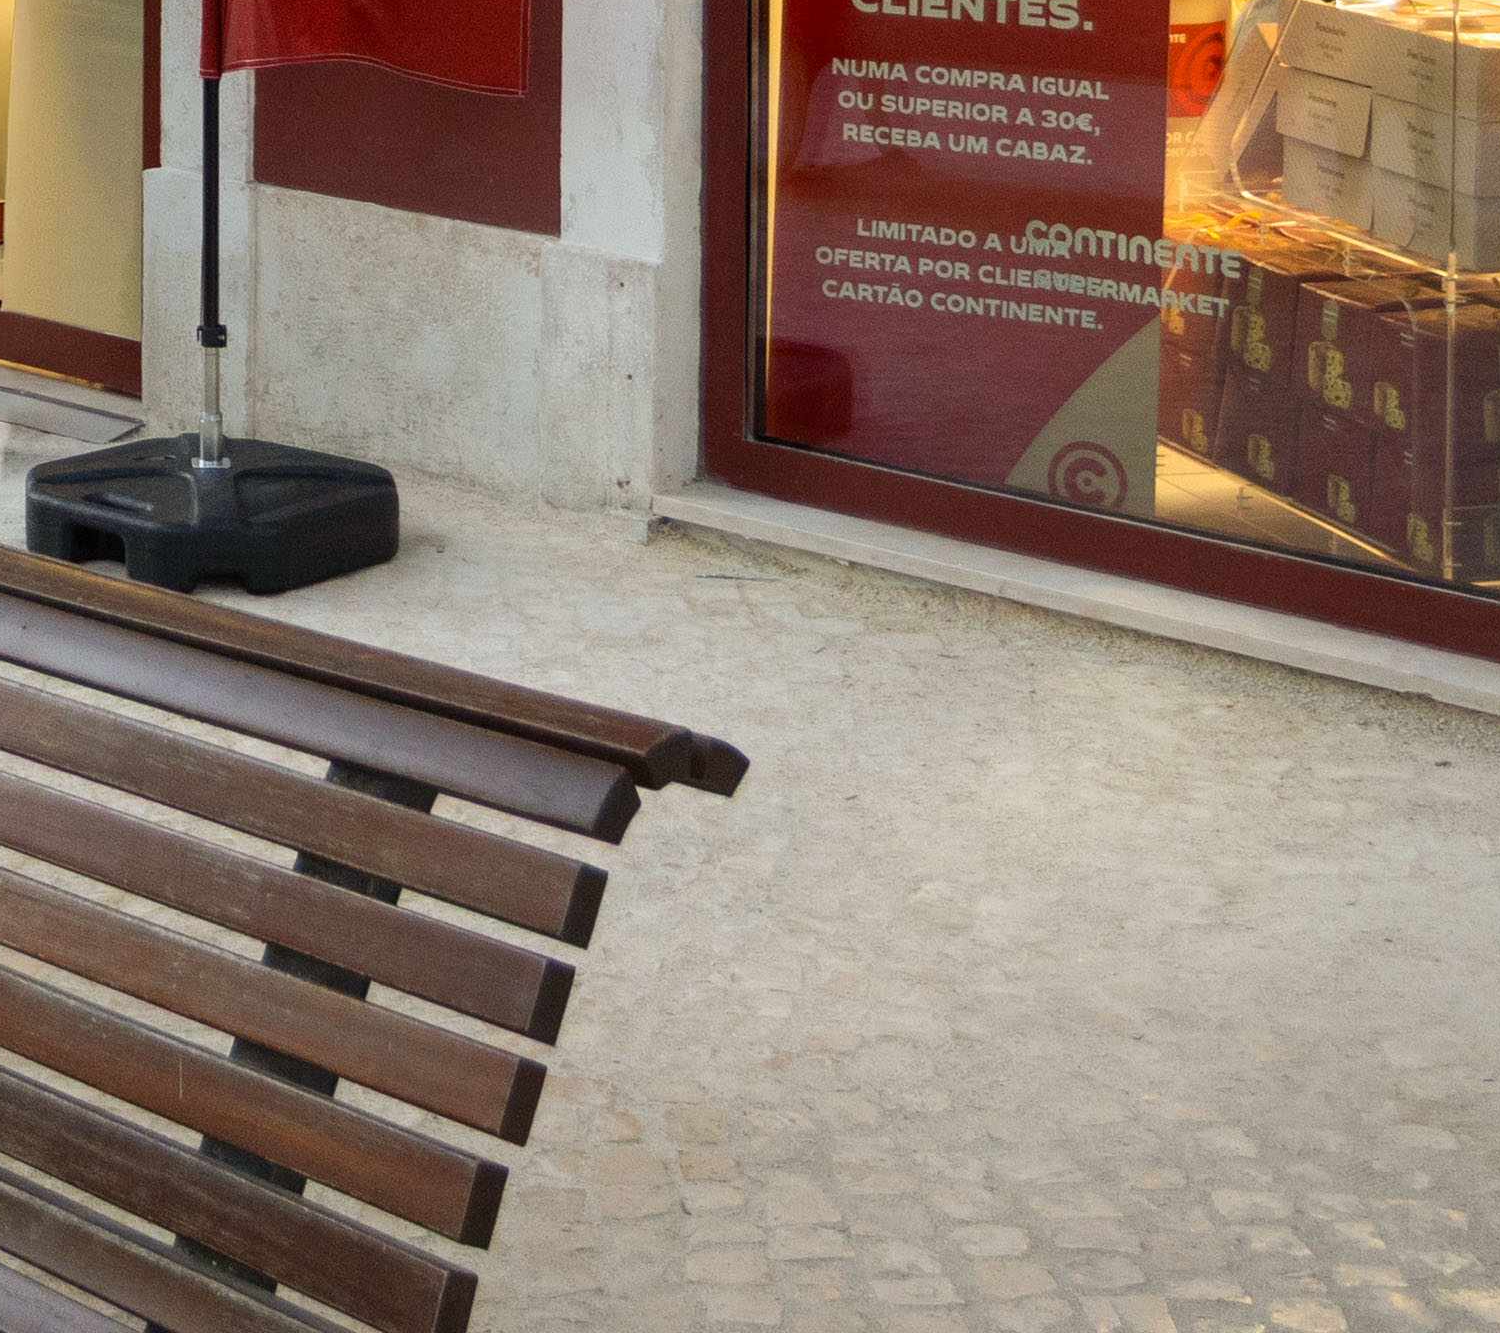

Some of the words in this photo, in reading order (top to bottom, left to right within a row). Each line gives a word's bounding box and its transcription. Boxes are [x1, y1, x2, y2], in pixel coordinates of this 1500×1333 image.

[831, 57, 909, 82] NUMA
[914, 65, 1027, 93] COMPRA
[1031, 76, 1110, 101] IGUAL
[837, 90, 875, 111] OU
[880, 94, 1008, 124] SUPERIOR
[1015, 107, 1035, 127] A
[1040, 109, 1101, 137] 30€,
[842, 122, 942, 150] RECEBA
[947, 133, 989, 155] UM
[995, 137, 1094, 166] CABAZ.
[855, 218, 977, 250] LIMITADO
[983, 232, 1004, 252] A
[1009, 235, 1072, 261] UMA
[1024, 219, 1242, 280] CONTINENTE
[815, 245, 911, 275] OFERTA
[917, 258, 971, 282] POR
[821, 277, 924, 309] CARTÃO
[929, 290, 1104, 331] CONTINENTE.
